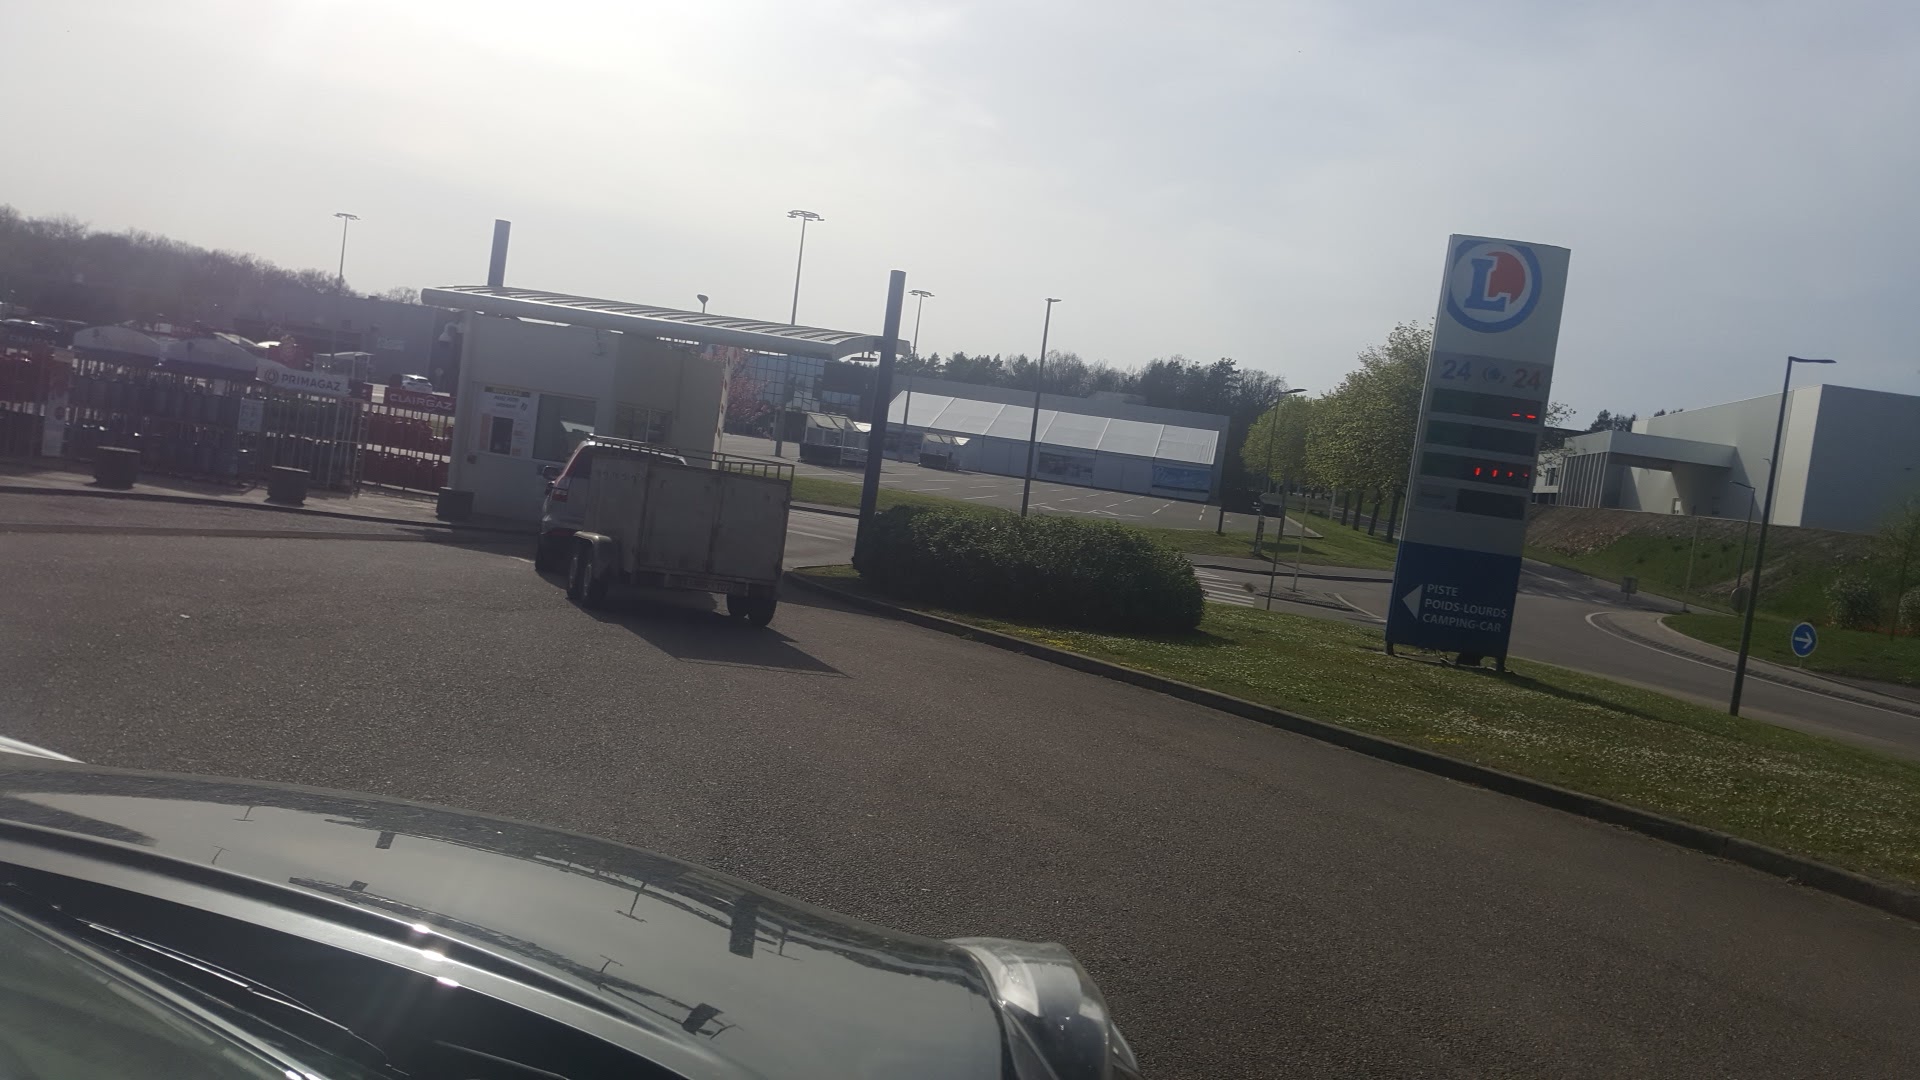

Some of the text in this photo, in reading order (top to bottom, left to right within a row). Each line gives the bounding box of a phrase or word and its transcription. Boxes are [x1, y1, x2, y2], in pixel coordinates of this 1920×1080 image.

[1463, 257, 1507, 313] L
[281, 374, 342, 392] PRIMAGAZ
[1440, 359, 1542, 392] 24 24
[389, 393, 454, 411] CLAIRGAZ
[1426, 583, 1459, 597] PISTE
[1424, 598, 1508, 619] POIDS-LOURDS
[1422, 613, 1502, 633] CAMPING-CAR
